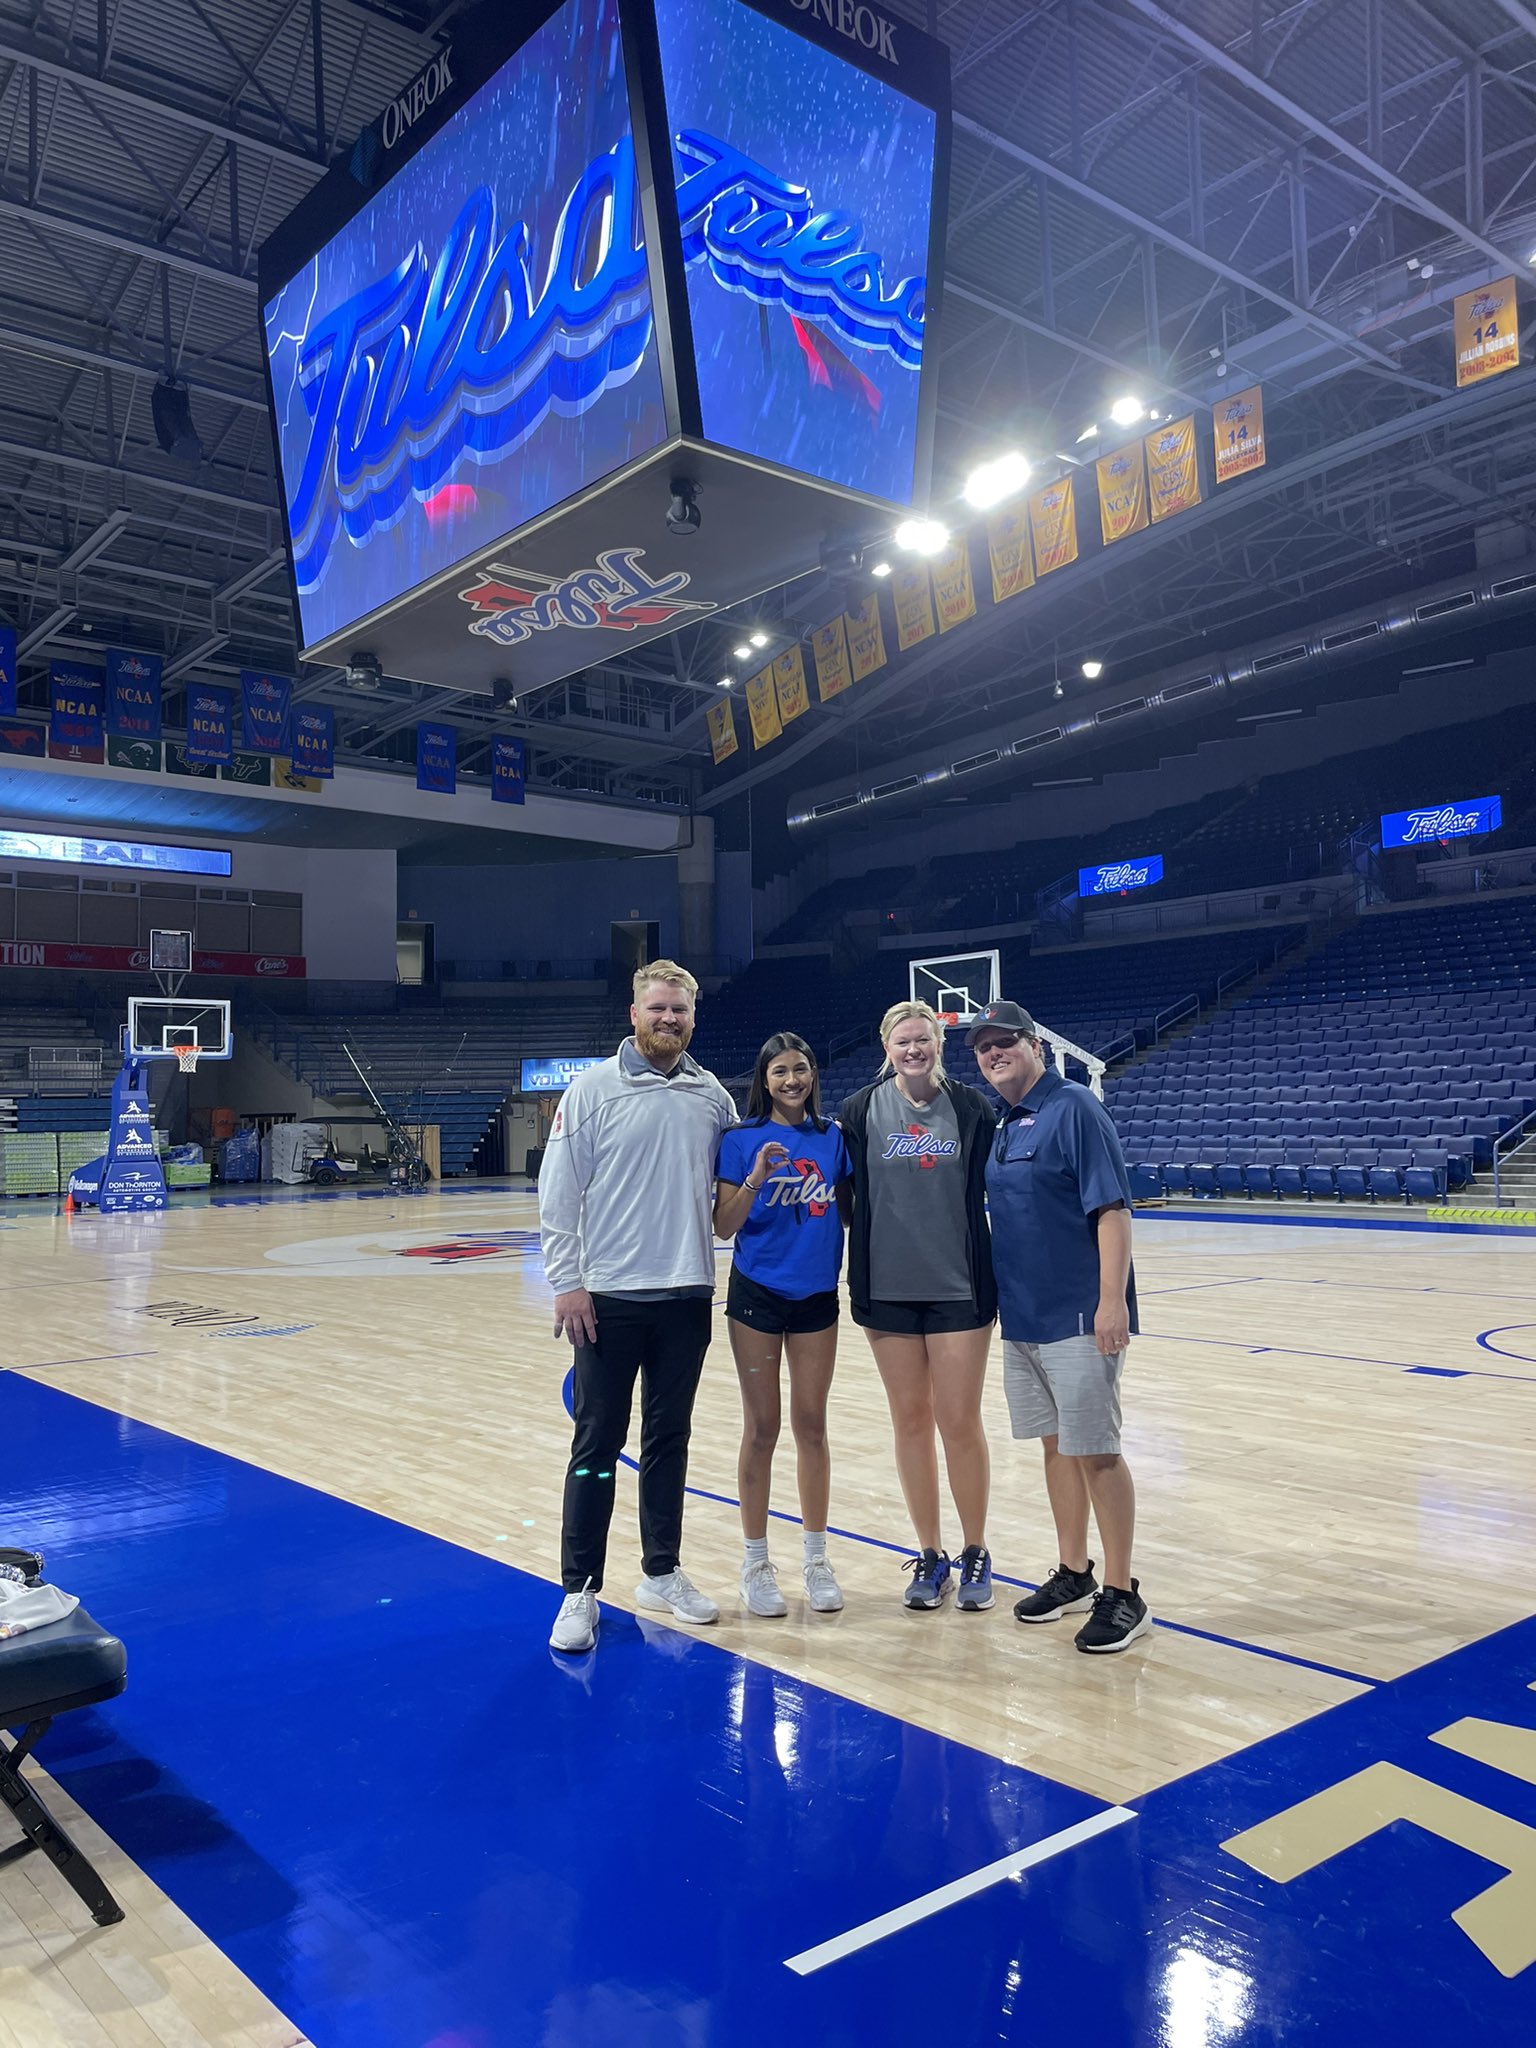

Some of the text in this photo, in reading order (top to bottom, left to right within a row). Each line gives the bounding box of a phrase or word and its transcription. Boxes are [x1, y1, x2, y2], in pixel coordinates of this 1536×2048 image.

[381, 46, 456, 150] ONEOK
[1473, 321, 1499, 344] 14
[291, 135, 653, 580] Tulsa
[1228, 425, 1249, 446] 14
[1217, 434, 1263, 461] JULIA SILVA
[1218, 452, 1264, 477] 2005-2007
[469, 548, 691, 645] Tulsa
[55, 698, 97, 717] NCAA
[116, 687, 153, 705] NCAA
[193, 719, 225, 735] NCAA
[250, 707, 282, 724] NCAA
[297, 735, 328, 751] NCAA
[1402, 807, 1480, 841] Tulsa
[1, 942, 46, 965] TION
[881, 1132, 957, 1159] Tulsa
